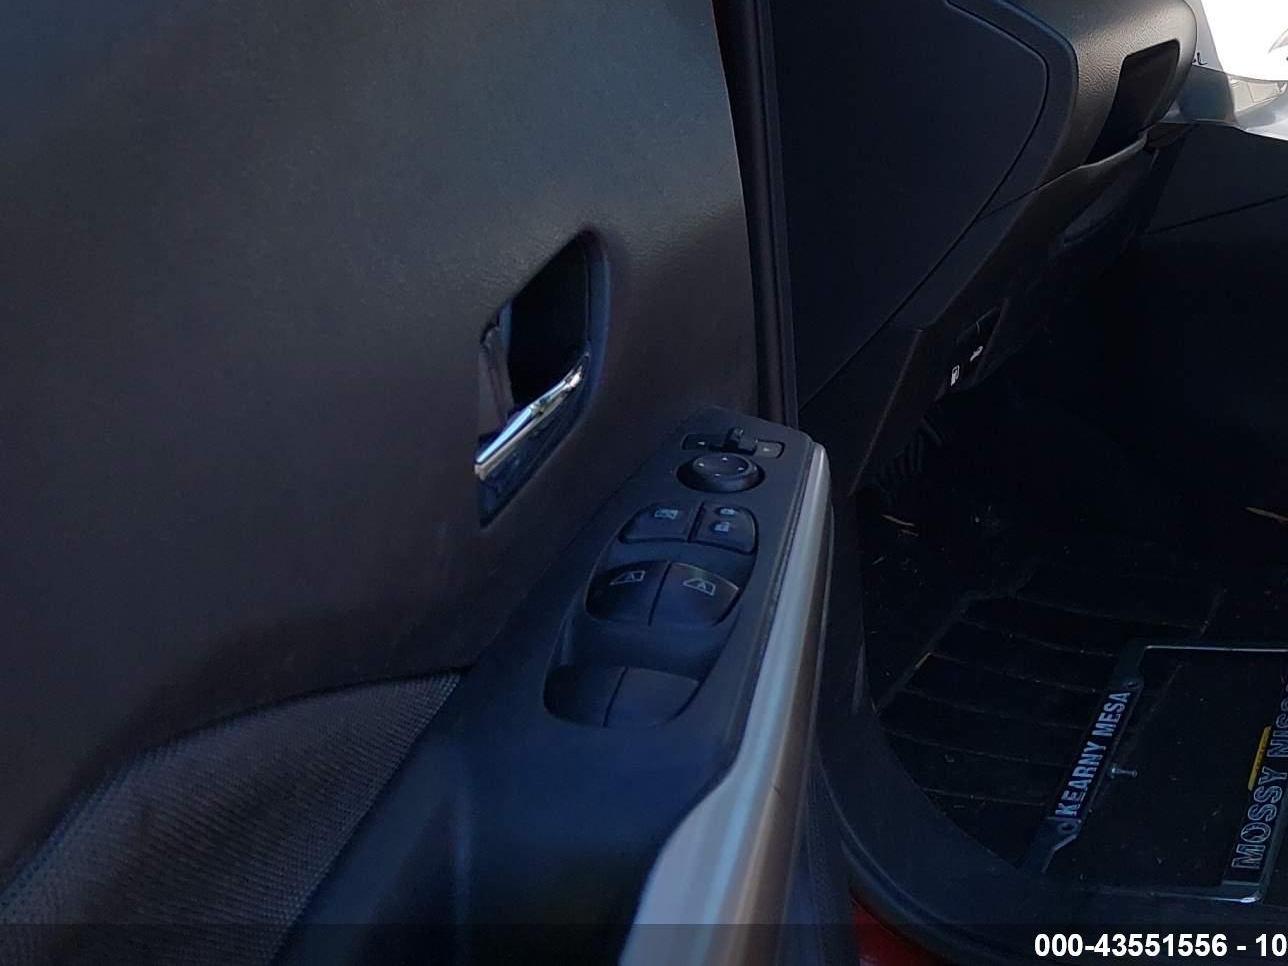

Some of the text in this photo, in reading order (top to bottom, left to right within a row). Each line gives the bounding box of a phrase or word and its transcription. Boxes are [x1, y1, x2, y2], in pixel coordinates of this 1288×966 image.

[1054, 690, 1131, 818] KEARNY MESA
[1230, 766, 1288, 871] MOSSY
